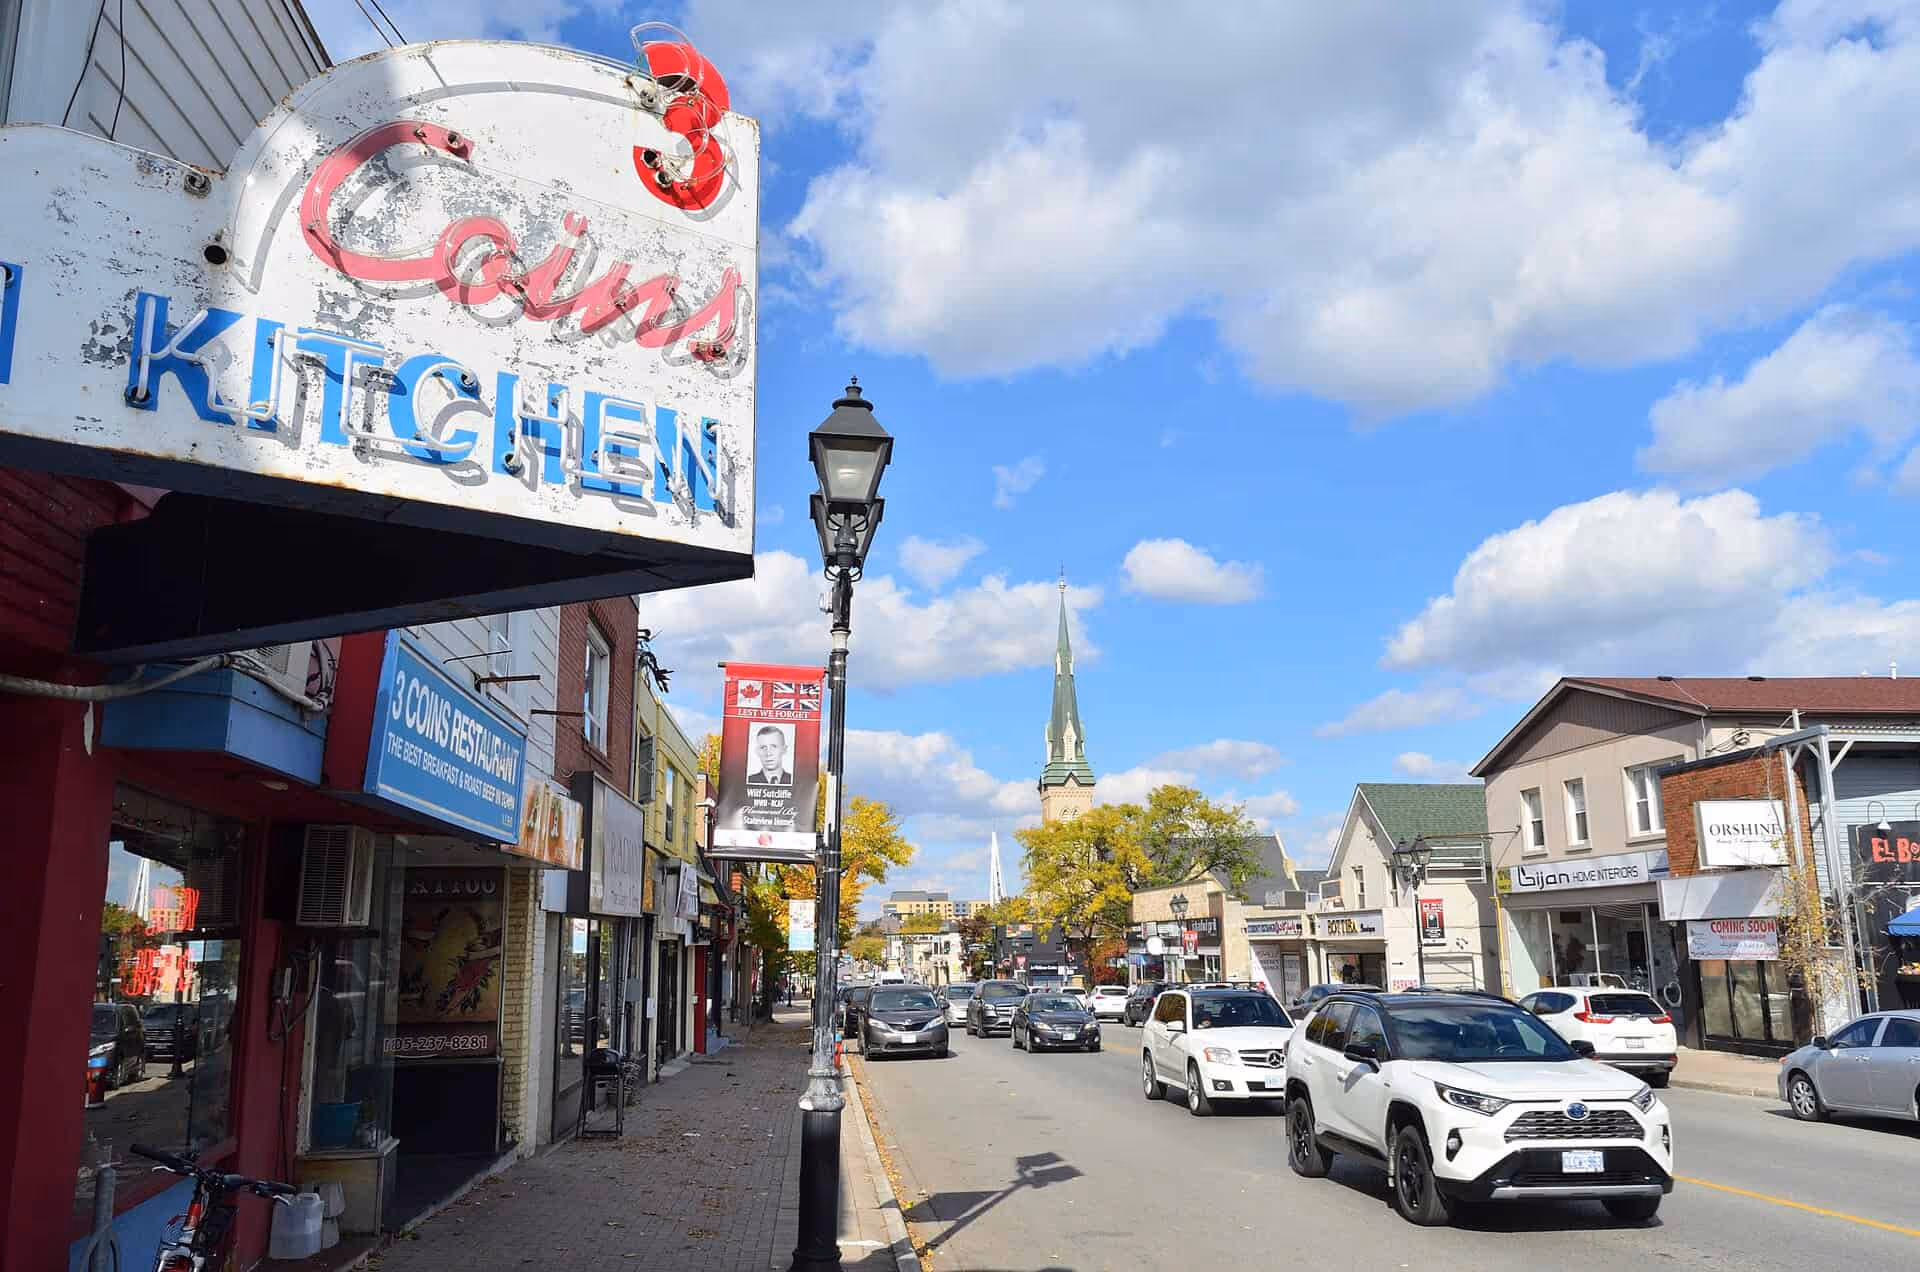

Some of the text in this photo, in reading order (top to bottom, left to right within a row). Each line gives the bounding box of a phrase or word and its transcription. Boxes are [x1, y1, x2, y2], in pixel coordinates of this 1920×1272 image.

[633, 41, 730, 210] 3
[125, 291, 720, 512] KITCHEN
[392, 670, 520, 785] 3 COINS RESTAURANT
[738, 708, 809, 719] LEST WE FORGET
[387, 732, 403, 759] THE
[403, 740, 423, 768] BEST
[423, 751, 459, 786] BREAKFAST
[459, 770, 464, 788] &
[464, 774, 483, 797] ROAST
[483, 781, 496, 801] BEEF
[746, 788, 792, 799] Wilf Sutcliffe
[1573, 870, 1596, 883] HOME
[1597, 865, 1638, 881] INTERIORS
[1711, 920, 1776, 934] COMING SOON
